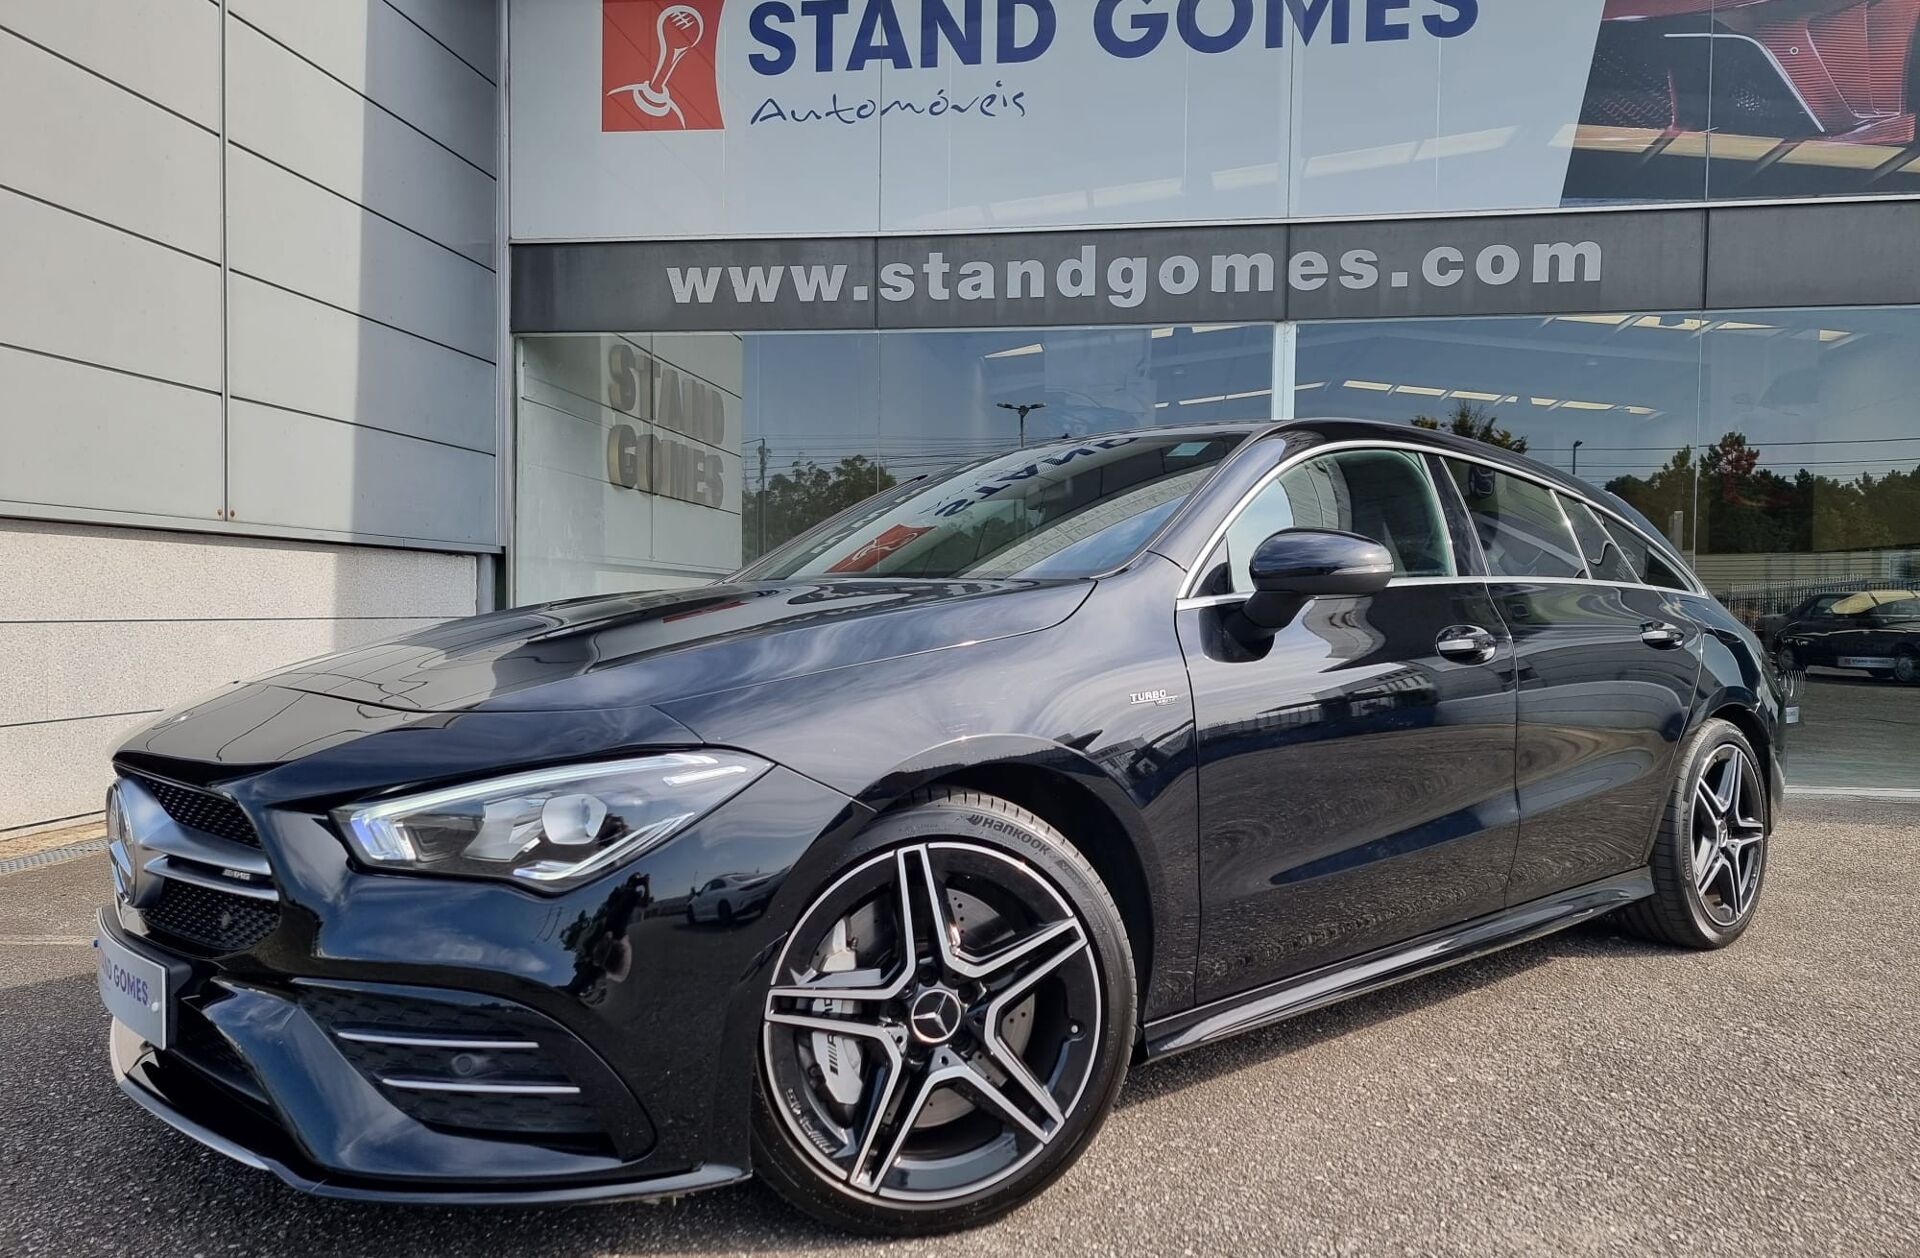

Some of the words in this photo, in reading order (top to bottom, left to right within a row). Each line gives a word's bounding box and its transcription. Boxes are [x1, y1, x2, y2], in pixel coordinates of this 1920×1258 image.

[747, 0, 1057, 76] STAND
[1092, 0, 1479, 59] GOMES
[750, 80, 1026, 126] Automóveis
[666, 239, 1602, 309] www.standgomes.com
[1129, 689, 1167, 703] TURBO
[114, 964, 149, 1006] GOMES
